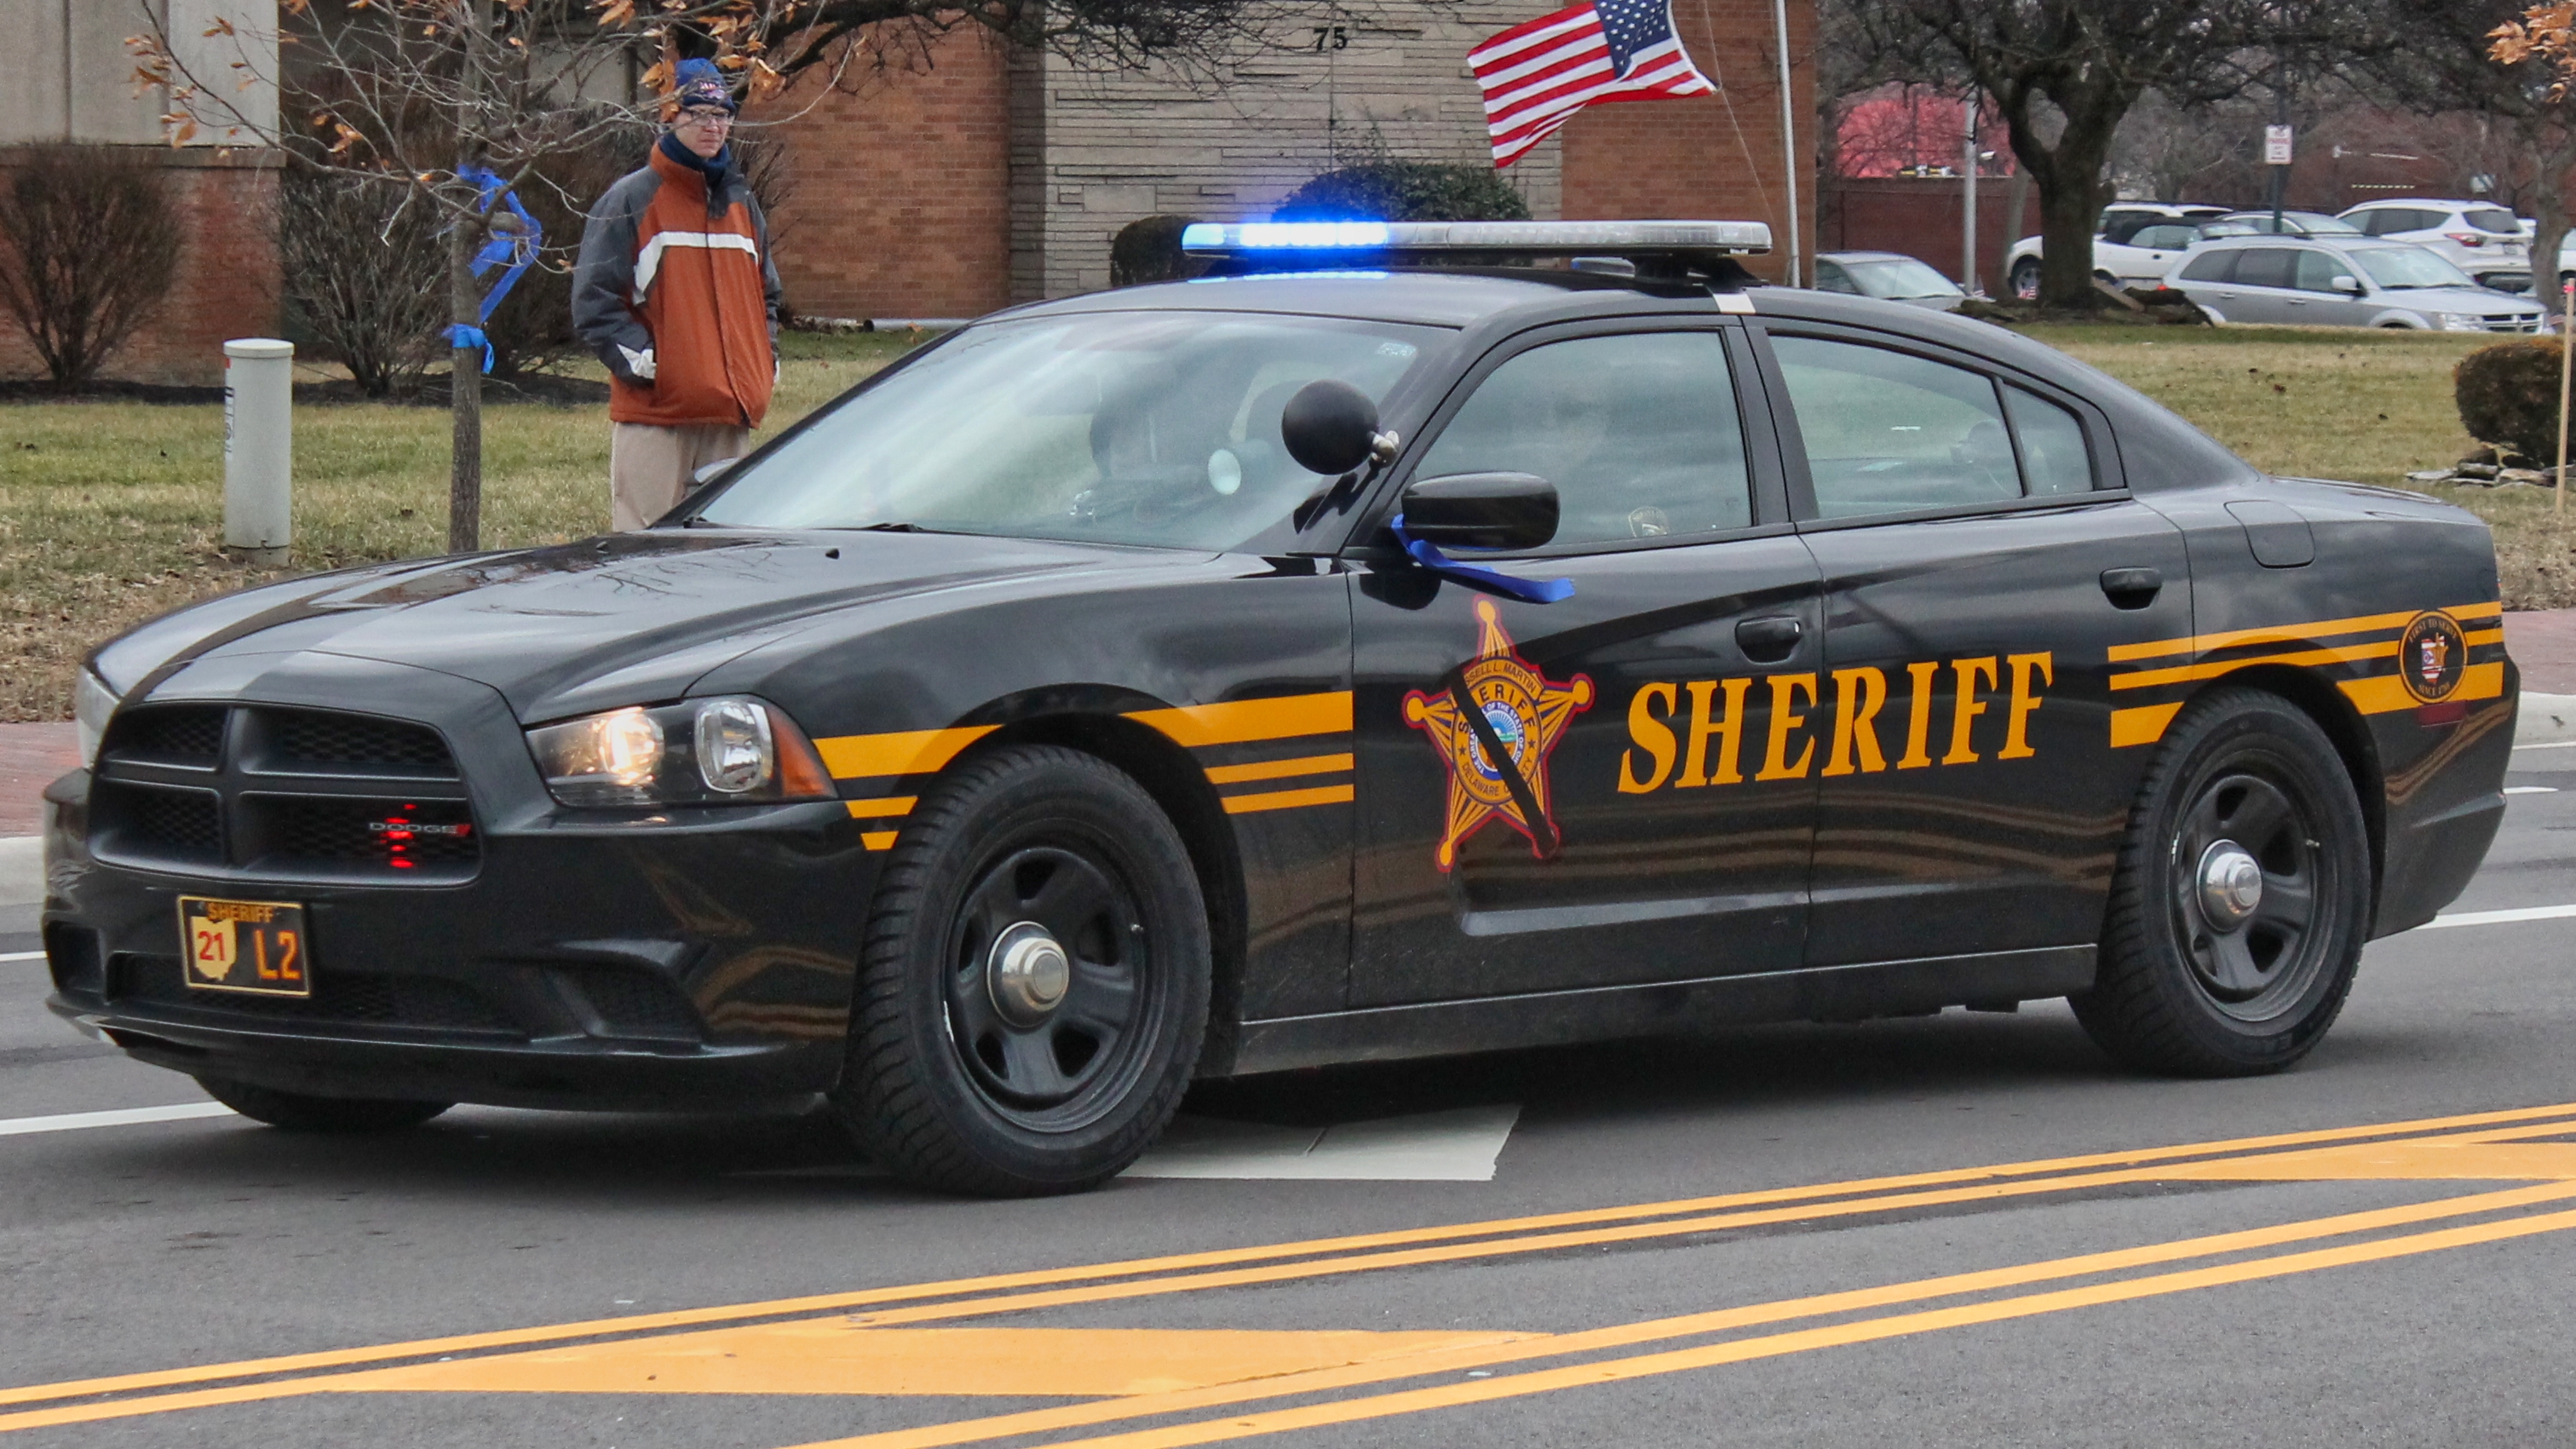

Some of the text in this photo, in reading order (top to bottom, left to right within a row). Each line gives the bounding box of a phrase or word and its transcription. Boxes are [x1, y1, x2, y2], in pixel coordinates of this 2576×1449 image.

[1314, 26, 1347, 51] 75
[2428, 618, 2438, 628] TO
[1465, 663, 1492, 686] SELL
[1503, 663, 1536, 693] MARTIN
[1458, 683, 1537, 733] SERIFF
[1619, 652, 2053, 794] SHERIFF
[1486, 702, 1496, 711] OF
[1497, 702, 1510, 714] THE
[1509, 709, 1524, 734] STATE
[1517, 736, 1524, 750] OF
[1462, 762, 1499, 796] DELAWARE
[369, 822, 457, 834] DODGE
[206, 901, 274, 923] SHERIFF
[198, 930, 227, 962] 21
[253, 929, 302, 980] L2
